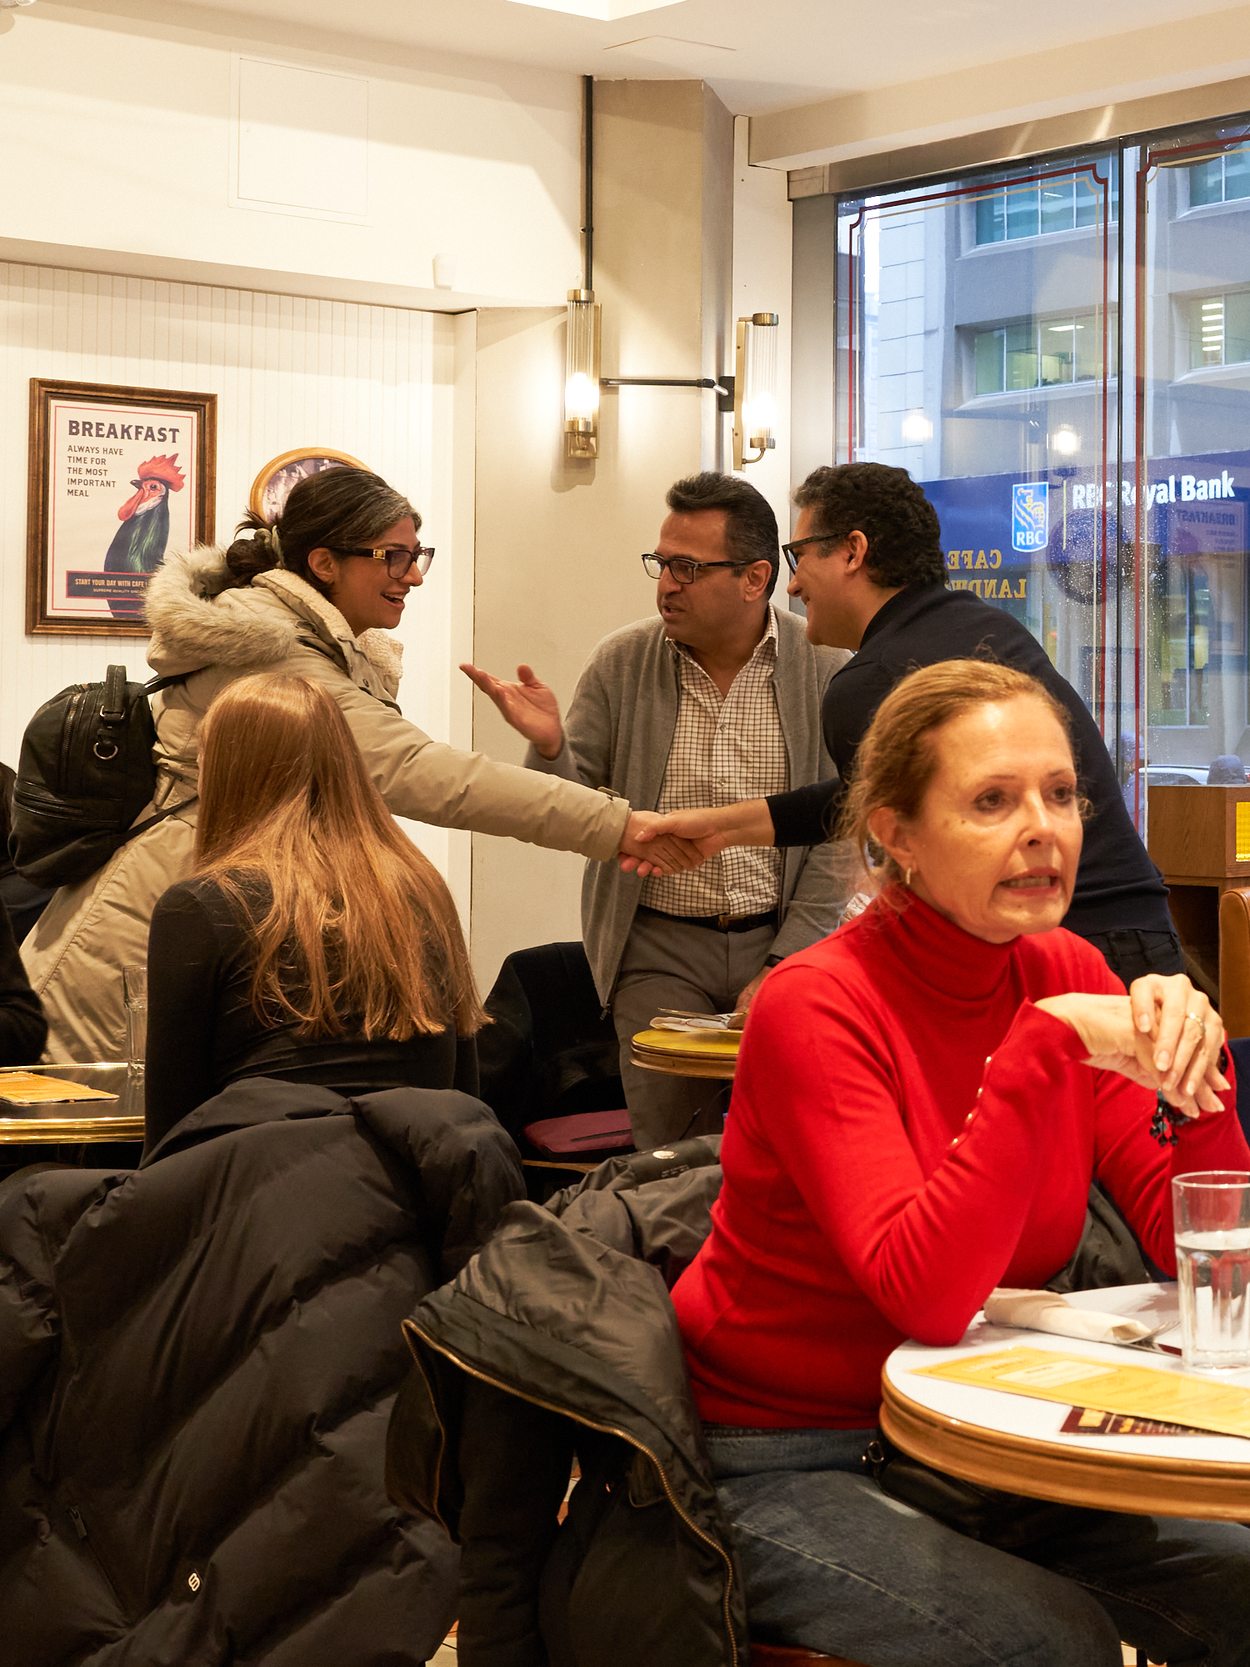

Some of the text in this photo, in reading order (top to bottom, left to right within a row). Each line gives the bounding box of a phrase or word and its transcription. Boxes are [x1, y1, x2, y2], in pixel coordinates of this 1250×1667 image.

[68, 420, 180, 443] BREAKFAST
[68, 445, 124, 455] ALWAYS HAVE
[67, 456, 107, 465] TIME FOR
[67, 467, 108, 476] THE MOST
[67, 478, 116, 488] IMPORTANT
[1181, 470, 1236, 501] Bank
[67, 489, 89, 497] MEAL
[1016, 531, 1044, 546] RBC
